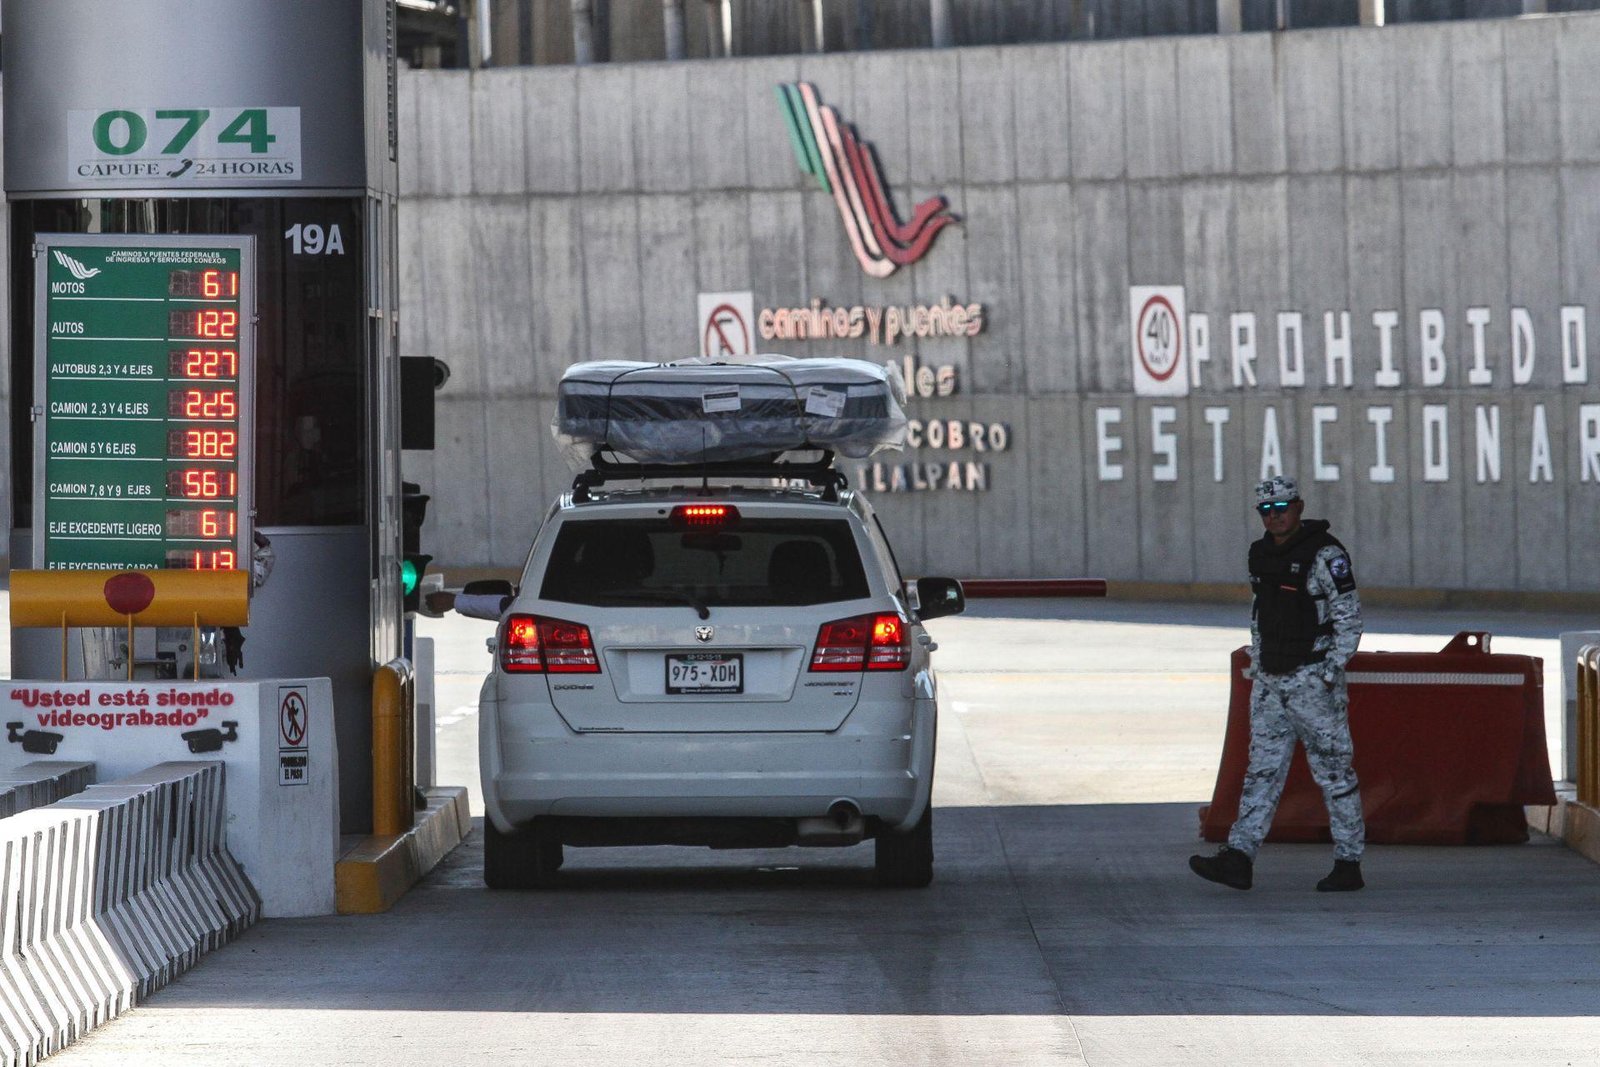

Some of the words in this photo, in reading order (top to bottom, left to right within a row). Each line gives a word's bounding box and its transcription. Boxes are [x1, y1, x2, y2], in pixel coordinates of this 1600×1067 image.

[92, 108, 277, 156] 074
[77, 163, 160, 177] CAPUFE
[195, 163, 216, 175] 24
[221, 161, 295, 175] HORAS
[284, 223, 345, 255] 19A
[111, 250, 142, 258] CAMINOS
[143, 250, 149, 258] Y
[149, 250, 179, 258] PUENTES
[180, 251, 220, 259] FEDERALES
[116, 256, 150, 264] INGRESOS
[151, 256, 157, 264] Y
[157, 256, 193, 264] SERVICIOS
[193, 257, 227, 265] CONEXOS
[51, 282, 85, 294] MOTOS
[203, 271, 237, 297] 61
[51, 322, 84, 334] AUTOS
[196, 311, 236, 337] 122
[758, 297, 865, 340] caminos
[885, 295, 982, 346] puentes
[1147, 311, 1170, 350] 40
[1189, 306, 1588, 388] PROHIBIDO
[51, 364, 97, 375] AUTOBUS
[99, 365, 112, 375] 2,3
[114, 365, 121, 375] Y
[122, 365, 128, 375] 4
[130, 365, 153, 375] EJES
[186, 351, 236, 377] 227
[51, 402, 88, 414] CAMION
[109, 404, 116, 415] Y
[117, 404, 123, 415] 4
[125, 404, 149, 415] EJES
[186, 391, 236, 417] 225
[51, 442, 88, 454] CAMION
[90, 443, 96, 454] 5
[98, 443, 105, 454] Y
[106, 443, 112, 454] 6
[113, 443, 136, 455] EJES
[187, 431, 235, 457] 382
[907, 420, 1007, 451] COBRO
[1097, 404, 1600, 483] ESTACIONAR
[50, 483, 87, 494] CAMION
[107, 485, 114, 496] Y
[115, 485, 121, 496] 9
[127, 485, 151, 495] EJES
[186, 471, 235, 497] 561
[857, 461, 988, 492] TLALPAN
[49, 522, 67, 533] EJE
[69, 522, 125, 534] EXCEDENTE
[126, 523, 162, 535] LIGERO
[202, 511, 235, 537] 61
[195, 551, 234, 570] 113
[672, 665, 737, 682] 975-XDH
[98, 689, 150, 707] está
[156, 689, 234, 707] siendo
